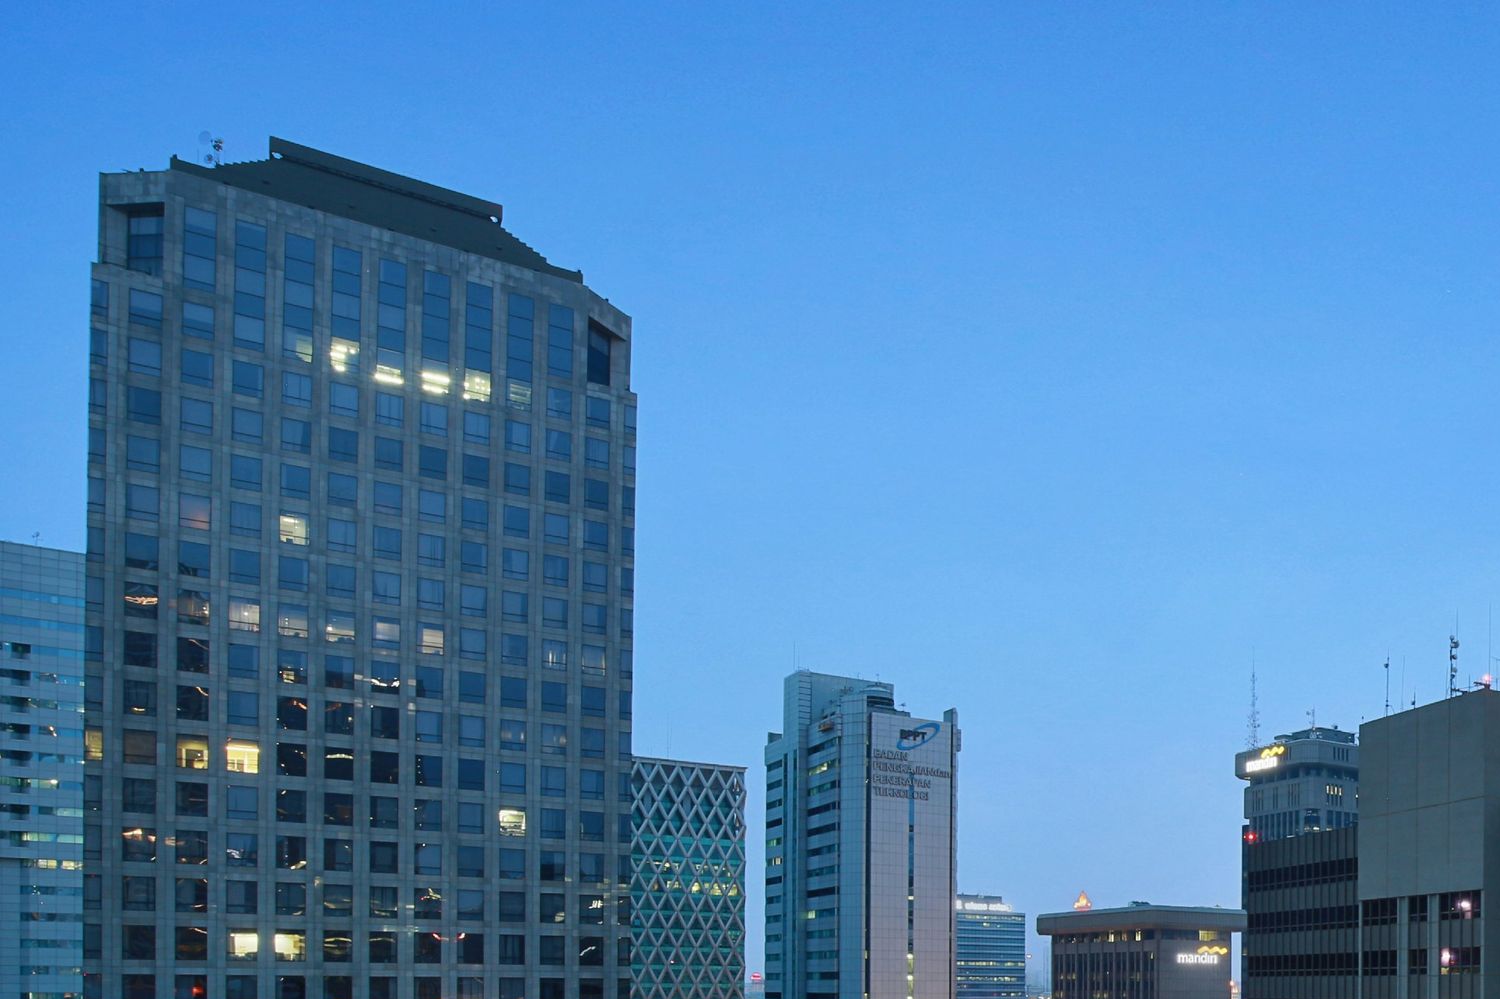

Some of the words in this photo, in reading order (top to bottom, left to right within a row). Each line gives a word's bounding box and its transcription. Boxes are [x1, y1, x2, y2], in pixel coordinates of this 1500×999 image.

[900, 729, 927, 741] BPPT
[873, 748, 908, 761] BADAN
[873, 773, 931, 789] PENERAPAN
[873, 786, 928, 801] TEKNOLOGI
[1176, 952, 1218, 964] mandiri
